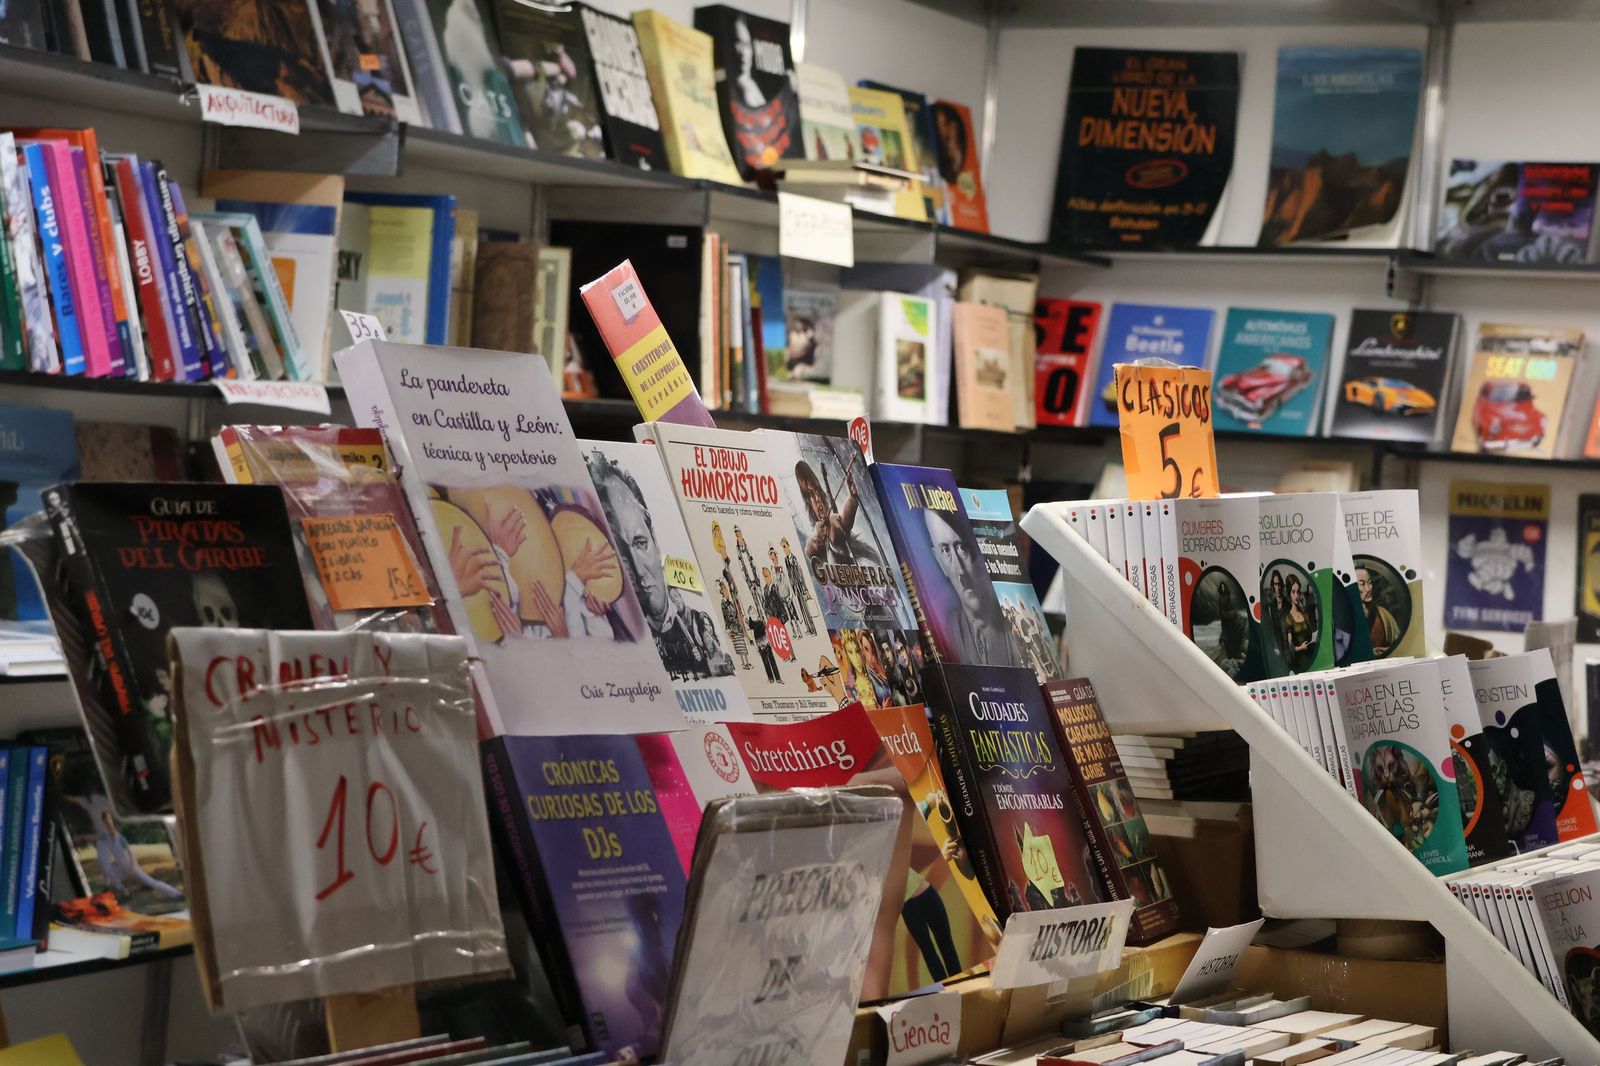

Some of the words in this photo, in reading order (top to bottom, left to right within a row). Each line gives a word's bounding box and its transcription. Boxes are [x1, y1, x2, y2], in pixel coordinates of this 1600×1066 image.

[1078, 112, 1216, 154] DIMENSIÓN
[157, 168, 181, 237] Campaign
[173, 236, 196, 307] Graphics
[132, 238, 155, 286] LOBBY
[1124, 335, 1185, 355] Beetle
[1350, 337, 1443, 361] Lamborghini
[1485, 356, 1525, 378] SEAT
[400, 368, 424, 390] La
[426, 372, 511, 399] pandereta
[412, 412, 432, 426] en
[434, 408, 496, 433] Castilla
[497, 420, 512, 442] y
[515, 416, 564, 437] León:
[422, 442, 471, 463] técnica
[470, 454, 486, 471] y
[485, 451, 559, 471] repertorio
[694, 446, 708, 468] EL
[711, 447, 749, 473] DIBUJO
[1158, 422, 1182, 499] 5
[1188, 467, 1205, 499] €
[901, 482, 920, 512] Mi
[921, 483, 958, 515] Lucha
[129, 515, 246, 545] PIRATAS
[1181, 520, 1224, 536] CUMBRES
[1259, 512, 1304, 530] RGULLO
[1345, 511, 1371, 528] RTE
[1373, 510, 1395, 525] DE
[1182, 535, 1251, 553] BORRASCOSAS
[1259, 528, 1314, 546] PREJUICIO
[177, 541, 273, 573] CARIBE
[811, 556, 896, 587] GUERRERAS
[767, 623, 790, 651] 10€
[374, 645, 393, 685] Y
[581, 683, 604, 699] Cris
[605, 682, 662, 703] Zagaleja
[675, 687, 728, 713] ANTINO
[1374, 683, 1395, 701] EN
[1399, 679, 1420, 695] EL
[1476, 684, 1528, 704] KENSTEIN
[968, 691, 1029, 722] CIUDADES
[1056, 703, 1097, 726] MOLUSCOS
[1365, 701, 1383, 720] DE
[1384, 697, 1415, 718] LAS
[881, 723, 923, 756] veda
[1065, 720, 1110, 745] CARACOLAS
[1351, 713, 1421, 741] MARAVILLAS
[743, 738, 855, 773] Stretching
[969, 724, 1053, 764] FANTÁSTICAS
[1071, 747, 1082, 765] DE
[1082, 743, 1104, 763] MAR
[542, 753, 620, 787] CRÓNICAS
[1080, 761, 1106, 781] CARIBE
[956, 767, 973, 817] CIUDADES
[992, 784, 998, 794] Y
[996, 794, 1064, 811] ENCONTRARLAS
[528, 792, 604, 820] CURIOSAS
[603, 791, 628, 815] DE
[626, 789, 657, 814] LOS
[315, 774, 400, 901] 10
[408, 821, 438, 875] €
[582, 826, 622, 860] DJs
[1466, 844, 1475, 852] NA
[1029, 846, 1048, 882] 10
[1467, 849, 1485, 858] RANK
[1028, 914, 1116, 963] HISTORIA
[1197, 953, 1240, 977] HISTORIA
[889, 1003, 951, 1054] Ciencia
